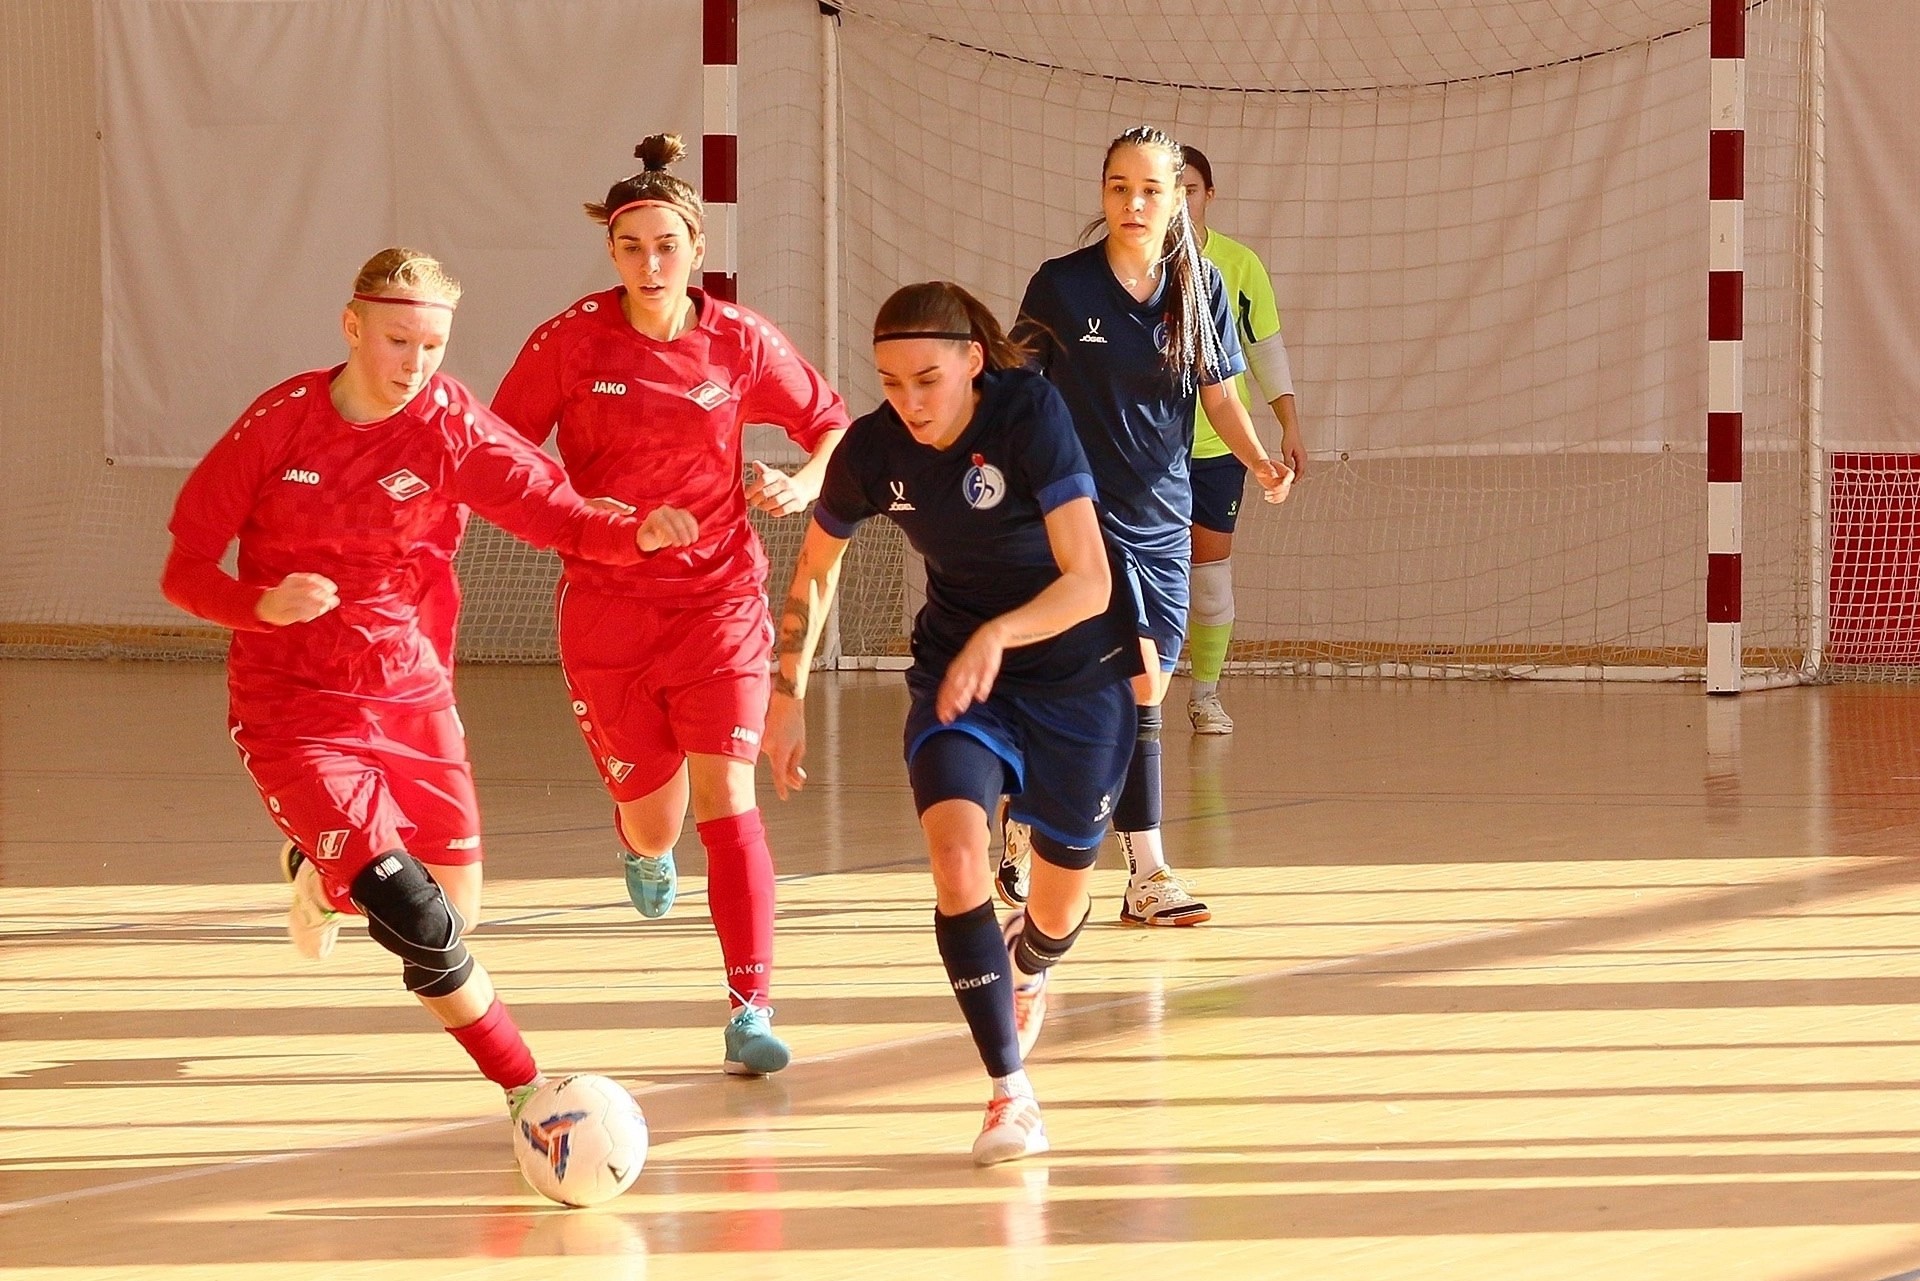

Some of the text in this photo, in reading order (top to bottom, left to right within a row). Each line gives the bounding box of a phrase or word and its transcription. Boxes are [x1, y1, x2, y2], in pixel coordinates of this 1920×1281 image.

[591, 380, 627, 396] JAKO
[281, 468, 320, 485] JAKO
[729, 962, 764, 976] JAKO
